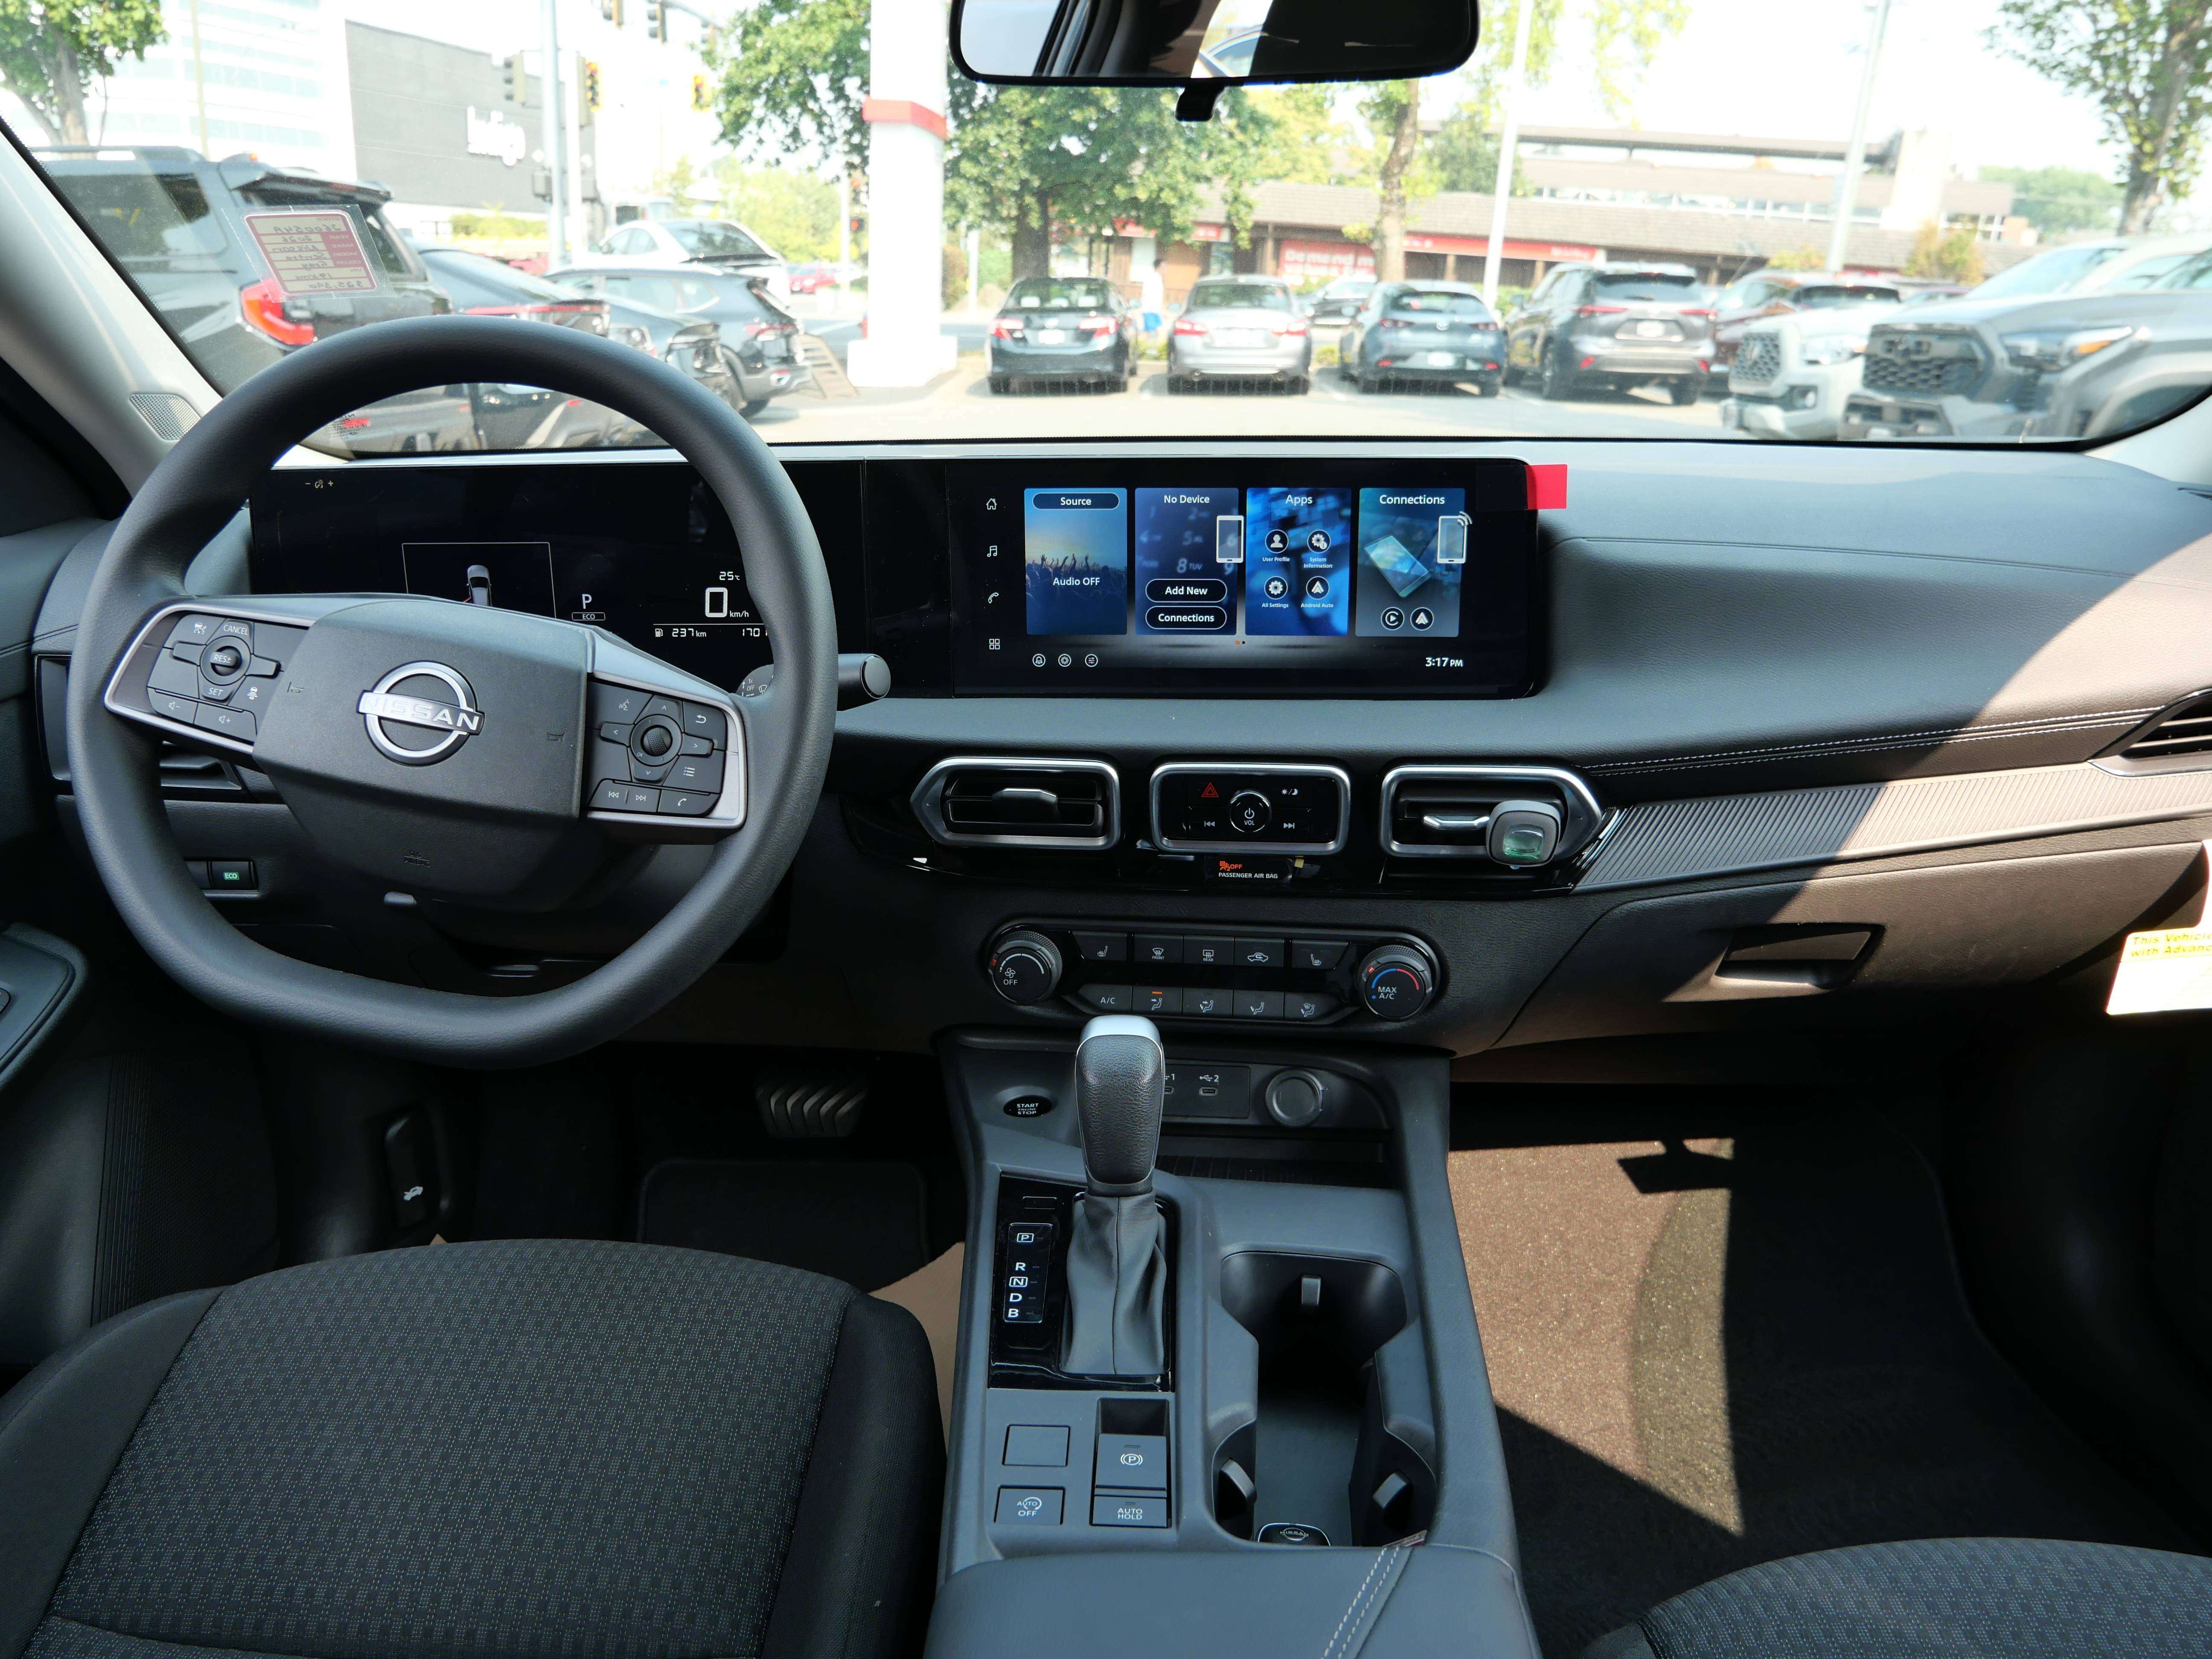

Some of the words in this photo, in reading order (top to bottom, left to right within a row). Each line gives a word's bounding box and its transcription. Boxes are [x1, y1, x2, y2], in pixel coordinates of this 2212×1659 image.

[1060, 497, 1091, 506] Source
[1164, 495, 1176, 504] No
[1180, 495, 1210, 504] Device
[1285, 495, 1313, 506] Apps
[1379, 495, 1445, 505] Connections
[1176, 558, 1187, 573] 8
[1053, 577, 1080, 586] Audio
[1083, 577, 1100, 586] OFF
[1165, 586, 1184, 595] Add
[1187, 586, 1208, 595] New
[582, 594, 592, 609] P
[705, 587, 728, 617] 0
[730, 610, 749, 618] km/h
[1158, 613, 1214, 622] Connections
[223, 624, 248, 635] CANCEL
[1426, 657, 1449, 667] 3:17
[1450, 659, 1463, 667] PM
[208, 688, 224, 696] SET
[363, 696, 480, 731] NISSAN
[2133, 936, 2159, 946] This
[2131, 948, 2158, 957] with
[1015, 1262, 1026, 1271] R
[1009, 1293, 1022, 1302] D
[1007, 1308, 1019, 1318] B
